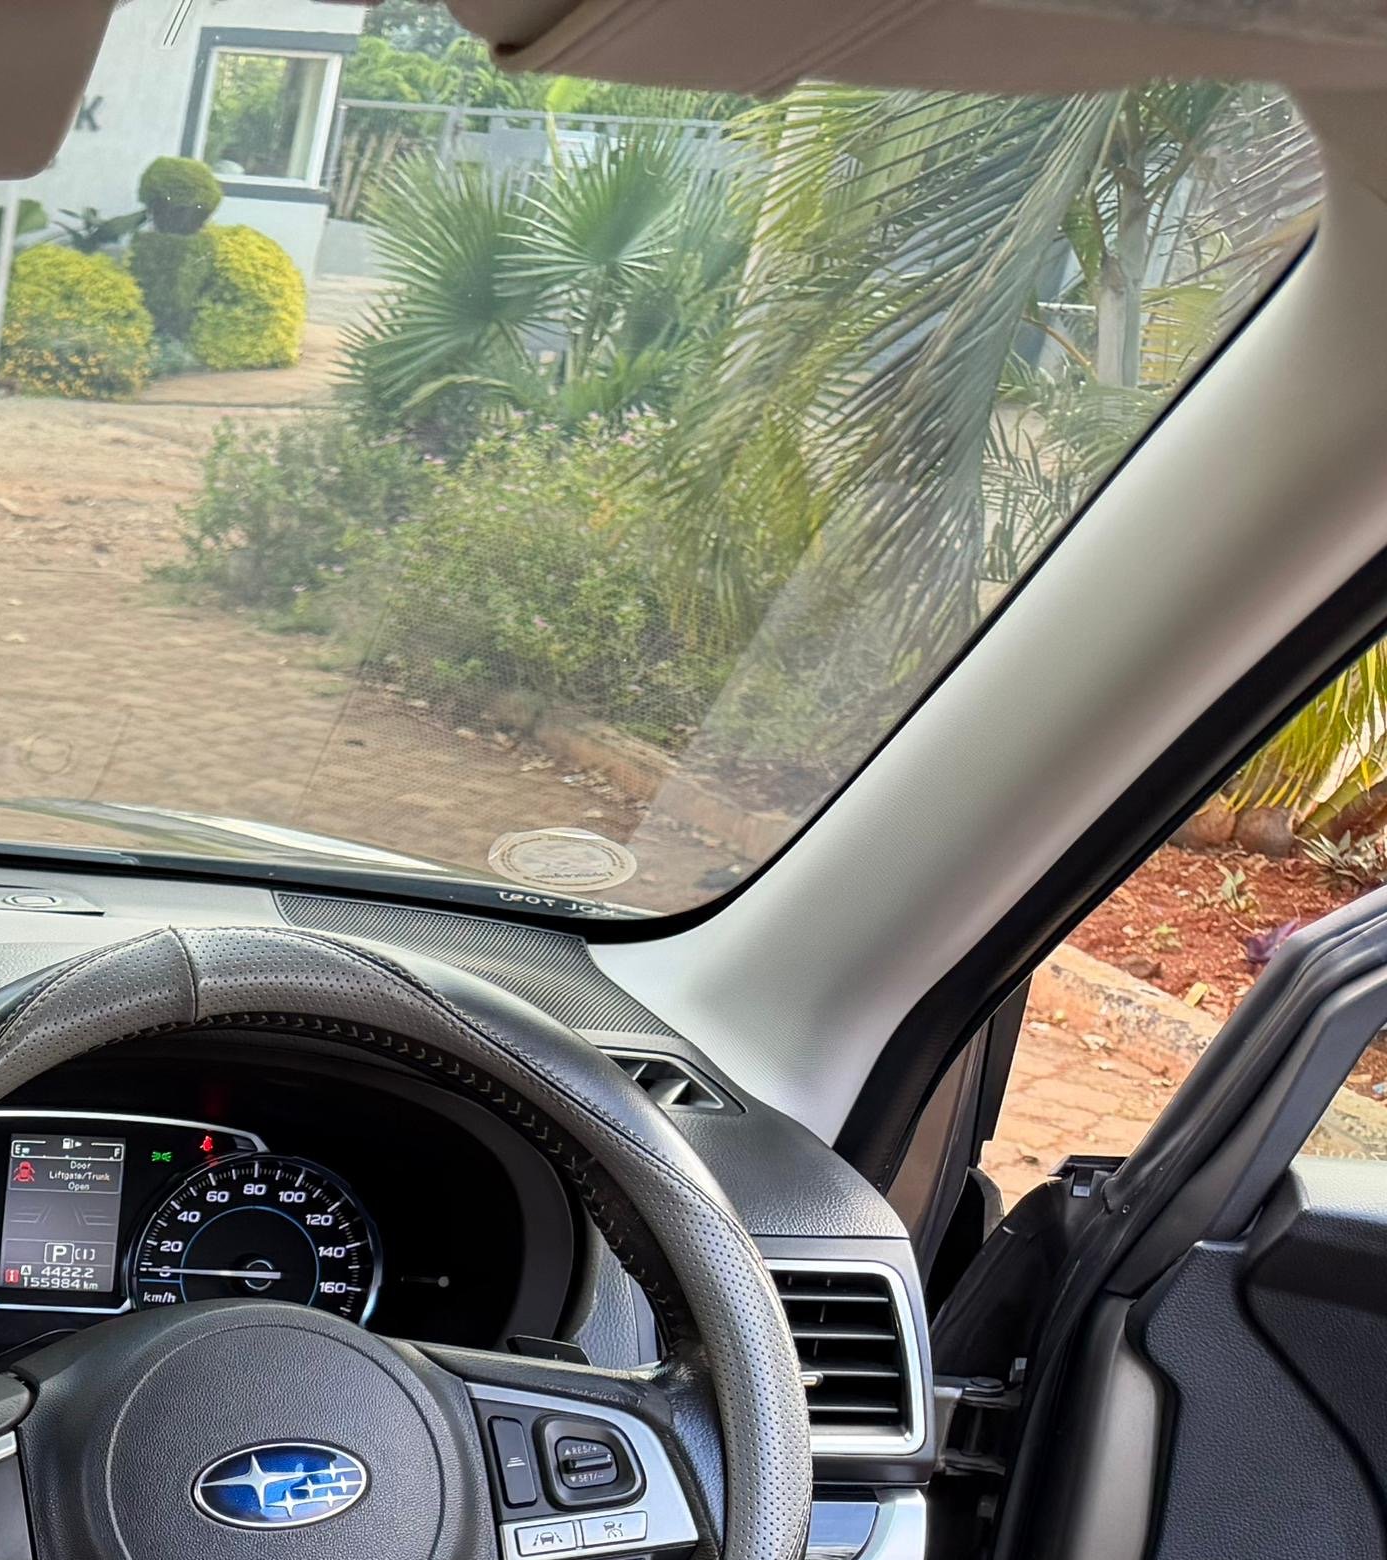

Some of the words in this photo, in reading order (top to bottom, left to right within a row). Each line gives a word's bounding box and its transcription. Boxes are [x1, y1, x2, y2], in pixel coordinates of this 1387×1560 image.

[70, 1161, 91, 1170] Door
[49, 1171, 110, 1182] Liftgate/Trunk
[67, 1182, 90, 1192] Open
[243, 1184, 267, 1196] 80
[206, 1191, 230, 1203] 60
[278, 1191, 306, 1203] 100
[177, 1211, 201, 1223] 40
[305, 1214, 333, 1226] 120
[160, 1241, 183, 1253] 20
[318, 1247, 346, 1259] 140
[52, 1246, 67, 1261] P
[41, 1267, 94, 1278] 4422.2
[22, 1277, 80, 1289] 155984
[83, 1280, 98, 1291] km
[319, 1282, 346, 1294] 160
[143, 1292, 176, 1304] km/h
